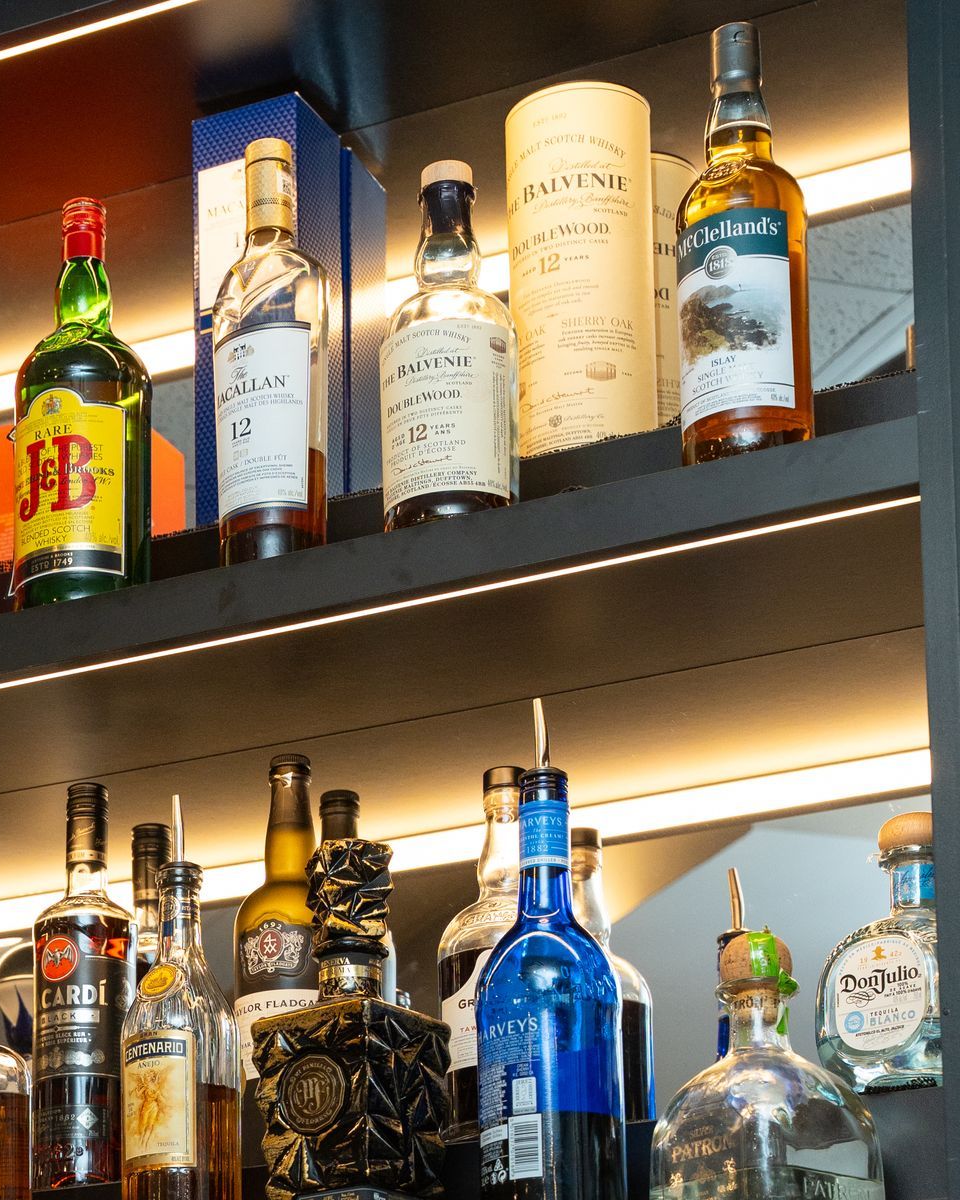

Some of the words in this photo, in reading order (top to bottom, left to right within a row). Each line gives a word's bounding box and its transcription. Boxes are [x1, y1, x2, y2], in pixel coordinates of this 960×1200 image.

[520, 142, 541, 161] MALT
[544, 134, 585, 146] SCOTCH
[589, 136, 626, 159] WHISKY
[524, 172, 628, 204] BALVENIE
[593, 207, 628, 217] SCOTLAND
[512, 222, 610, 261] DOUBLEWOOD
[678, 217, 778, 262] McClelland's
[539, 253, 561, 276] 12
[561, 316, 606, 329] SHERRY
[611, 317, 635, 331] OAK
[395, 333, 411, 350] MALT
[411, 328, 440, 341] SCOTCH
[442, 330, 472, 344] WHISKY
[711, 355, 737, 368] ISLAY
[382, 373, 395, 393] THE
[397, 355, 473, 380] BALVENIE
[697, 366, 727, 383] SINGLE
[692, 378, 723, 395] SCOTCH
[387, 389, 461, 419] DOUBLEWOOD
[34, 424, 73, 441] RARE
[231, 417, 252, 441] 12
[408, 423, 429, 445] 12
[430, 423, 457, 431] YEARS
[418, 446, 456, 456] D'ÉCOSSE
[423, 440, 466, 448] SCOTLAND
[19, 434, 97, 523] J&B
[21, 529, 49, 546] BLENDED
[52, 525, 91, 536] SCOTCH
[35, 535, 68, 548] WHISKY
[53, 557, 73, 568] 1749
[259, 922, 282, 932] 1692
[41, 979, 108, 1009] CARDÍ
[266, 999, 316, 1010] FLADGA
[870, 1007, 899, 1017] TEQUILA
[41, 1014, 76, 1024] BLACK
[869, 1010, 916, 1026] BLANCO
[125, 1042, 183, 1062] CENTENARIO
[137, 1059, 161, 1069] AÑEJO
